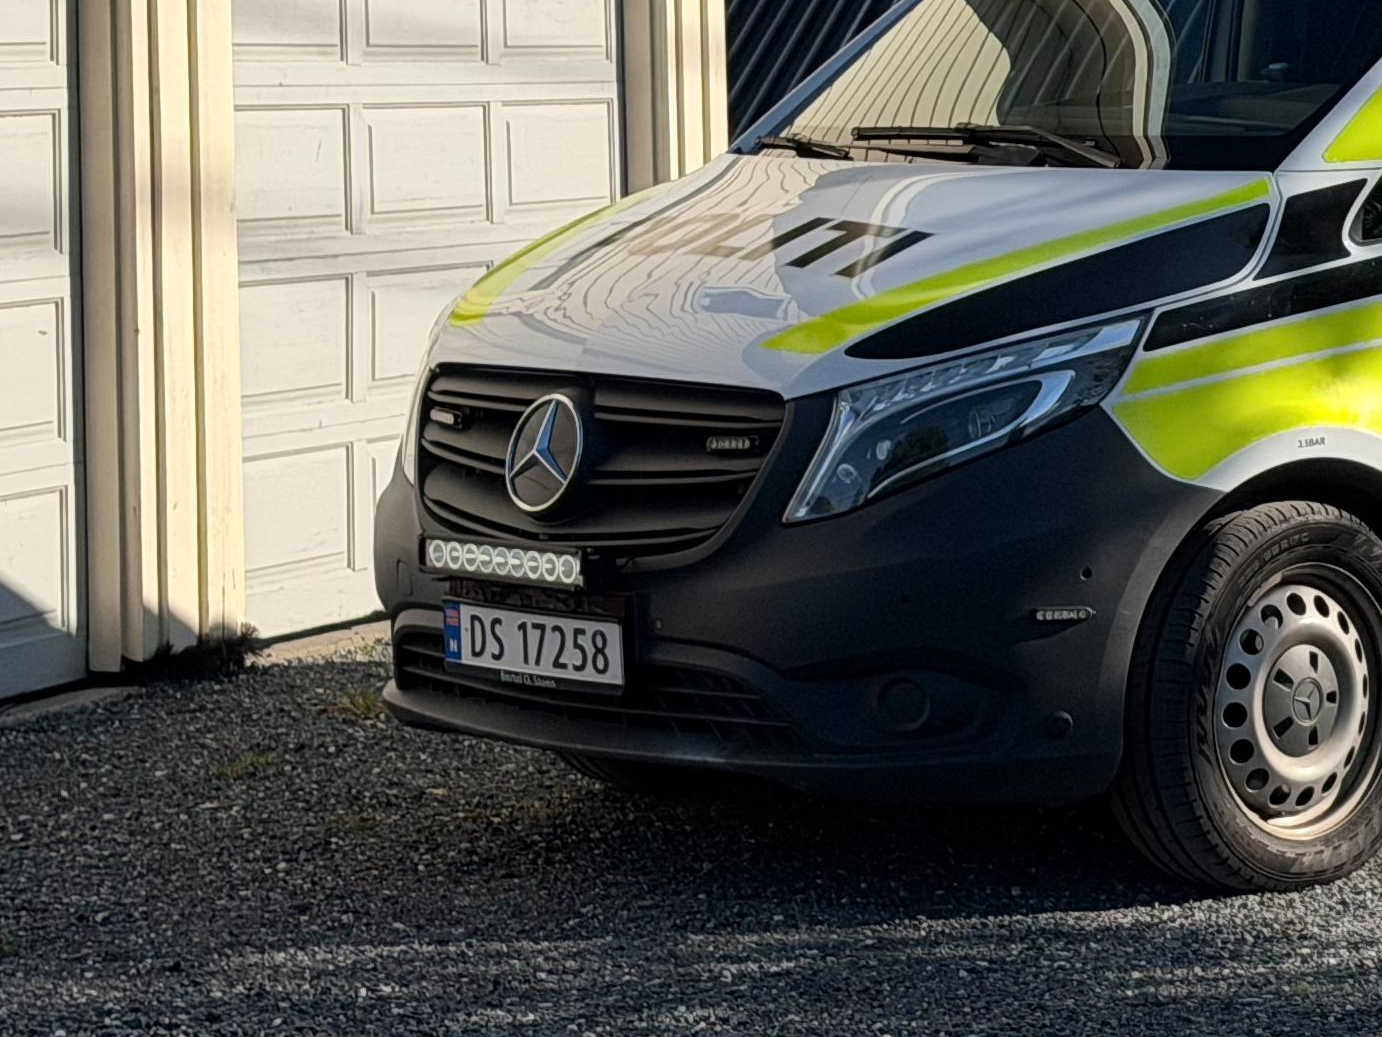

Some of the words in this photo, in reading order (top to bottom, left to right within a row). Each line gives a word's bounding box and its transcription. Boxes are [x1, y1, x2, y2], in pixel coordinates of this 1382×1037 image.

[449, 638, 458, 653] N
[470, 614, 505, 661] DS
[517, 621, 610, 675] 17258
